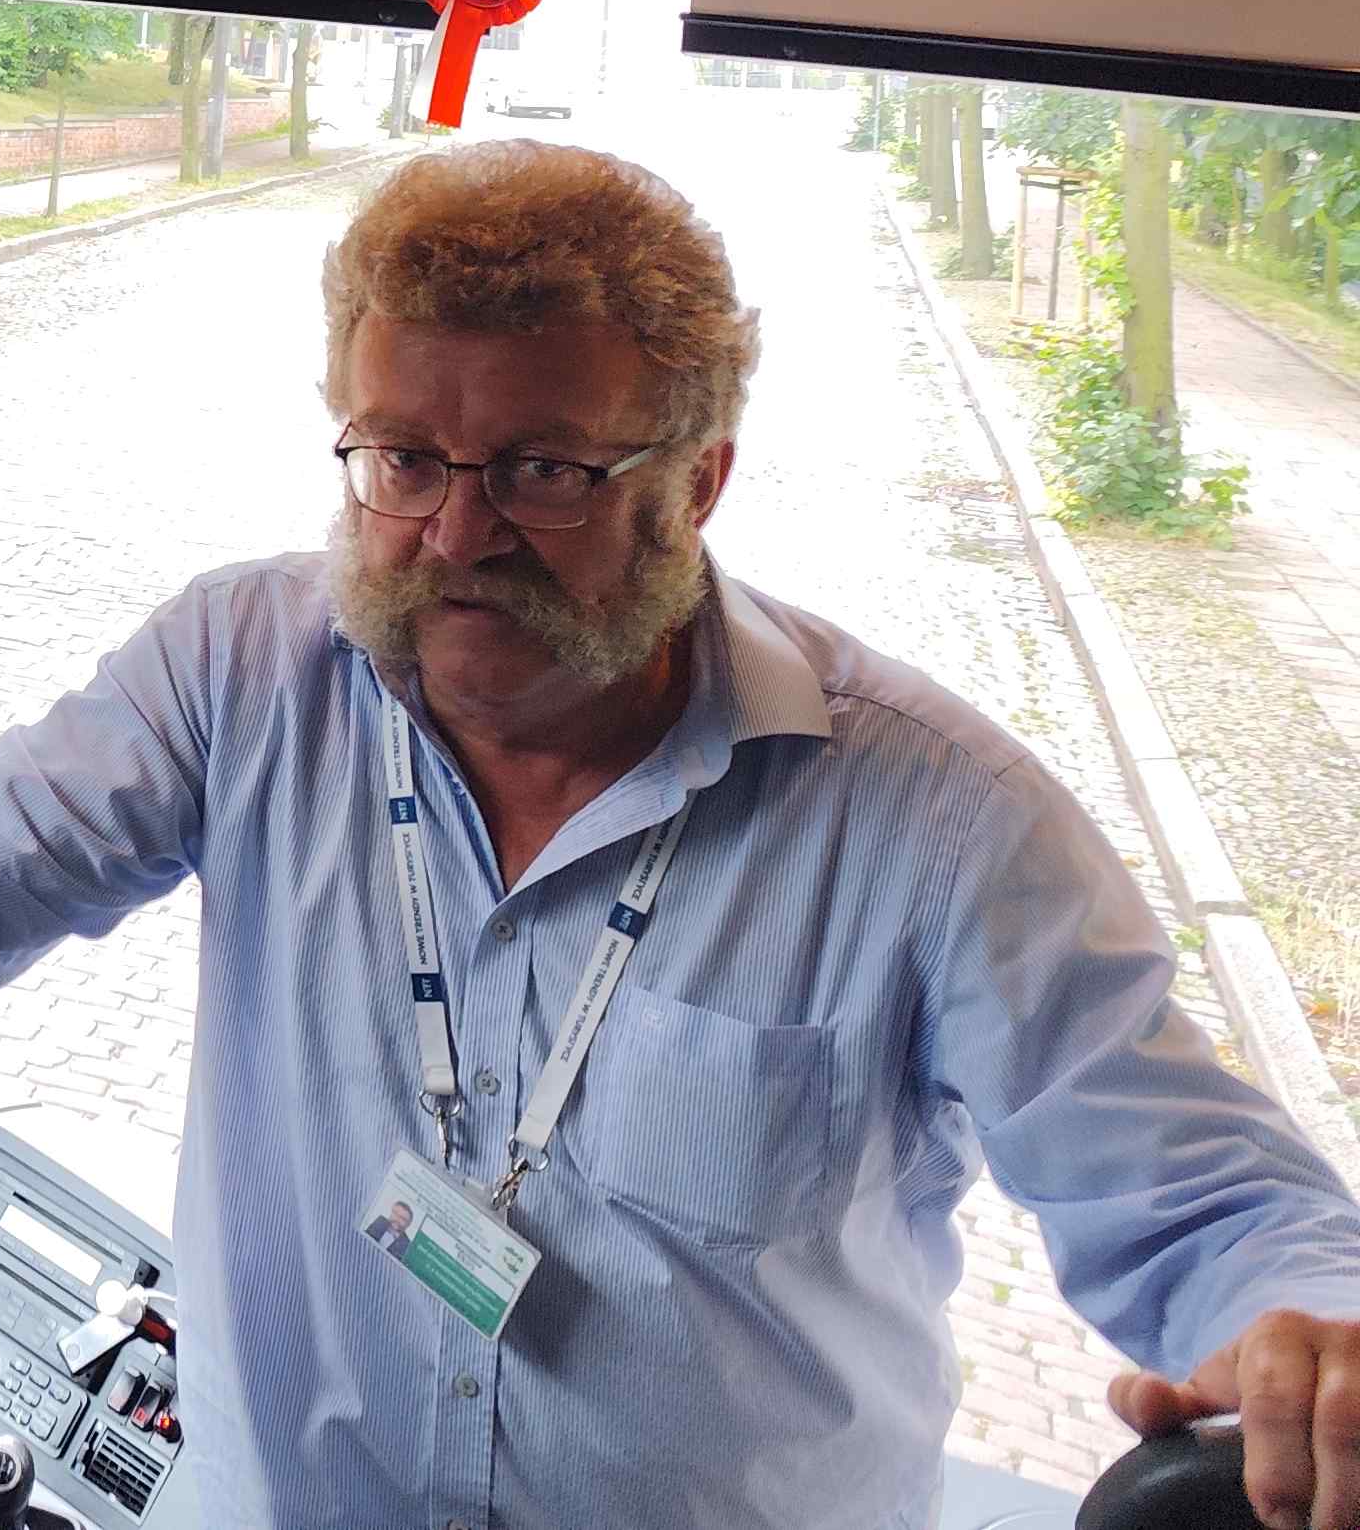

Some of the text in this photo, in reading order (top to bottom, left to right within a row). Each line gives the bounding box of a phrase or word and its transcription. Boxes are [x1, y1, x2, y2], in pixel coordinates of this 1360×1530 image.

[410, 885, 418, 894] W
[412, 897, 424, 934] TRENDY
[416, 934, 428, 966] NOWE
[603, 938, 619, 968] NOWE
[586, 969, 607, 1003] TRENDY
[582, 1004, 592, 1015] W
